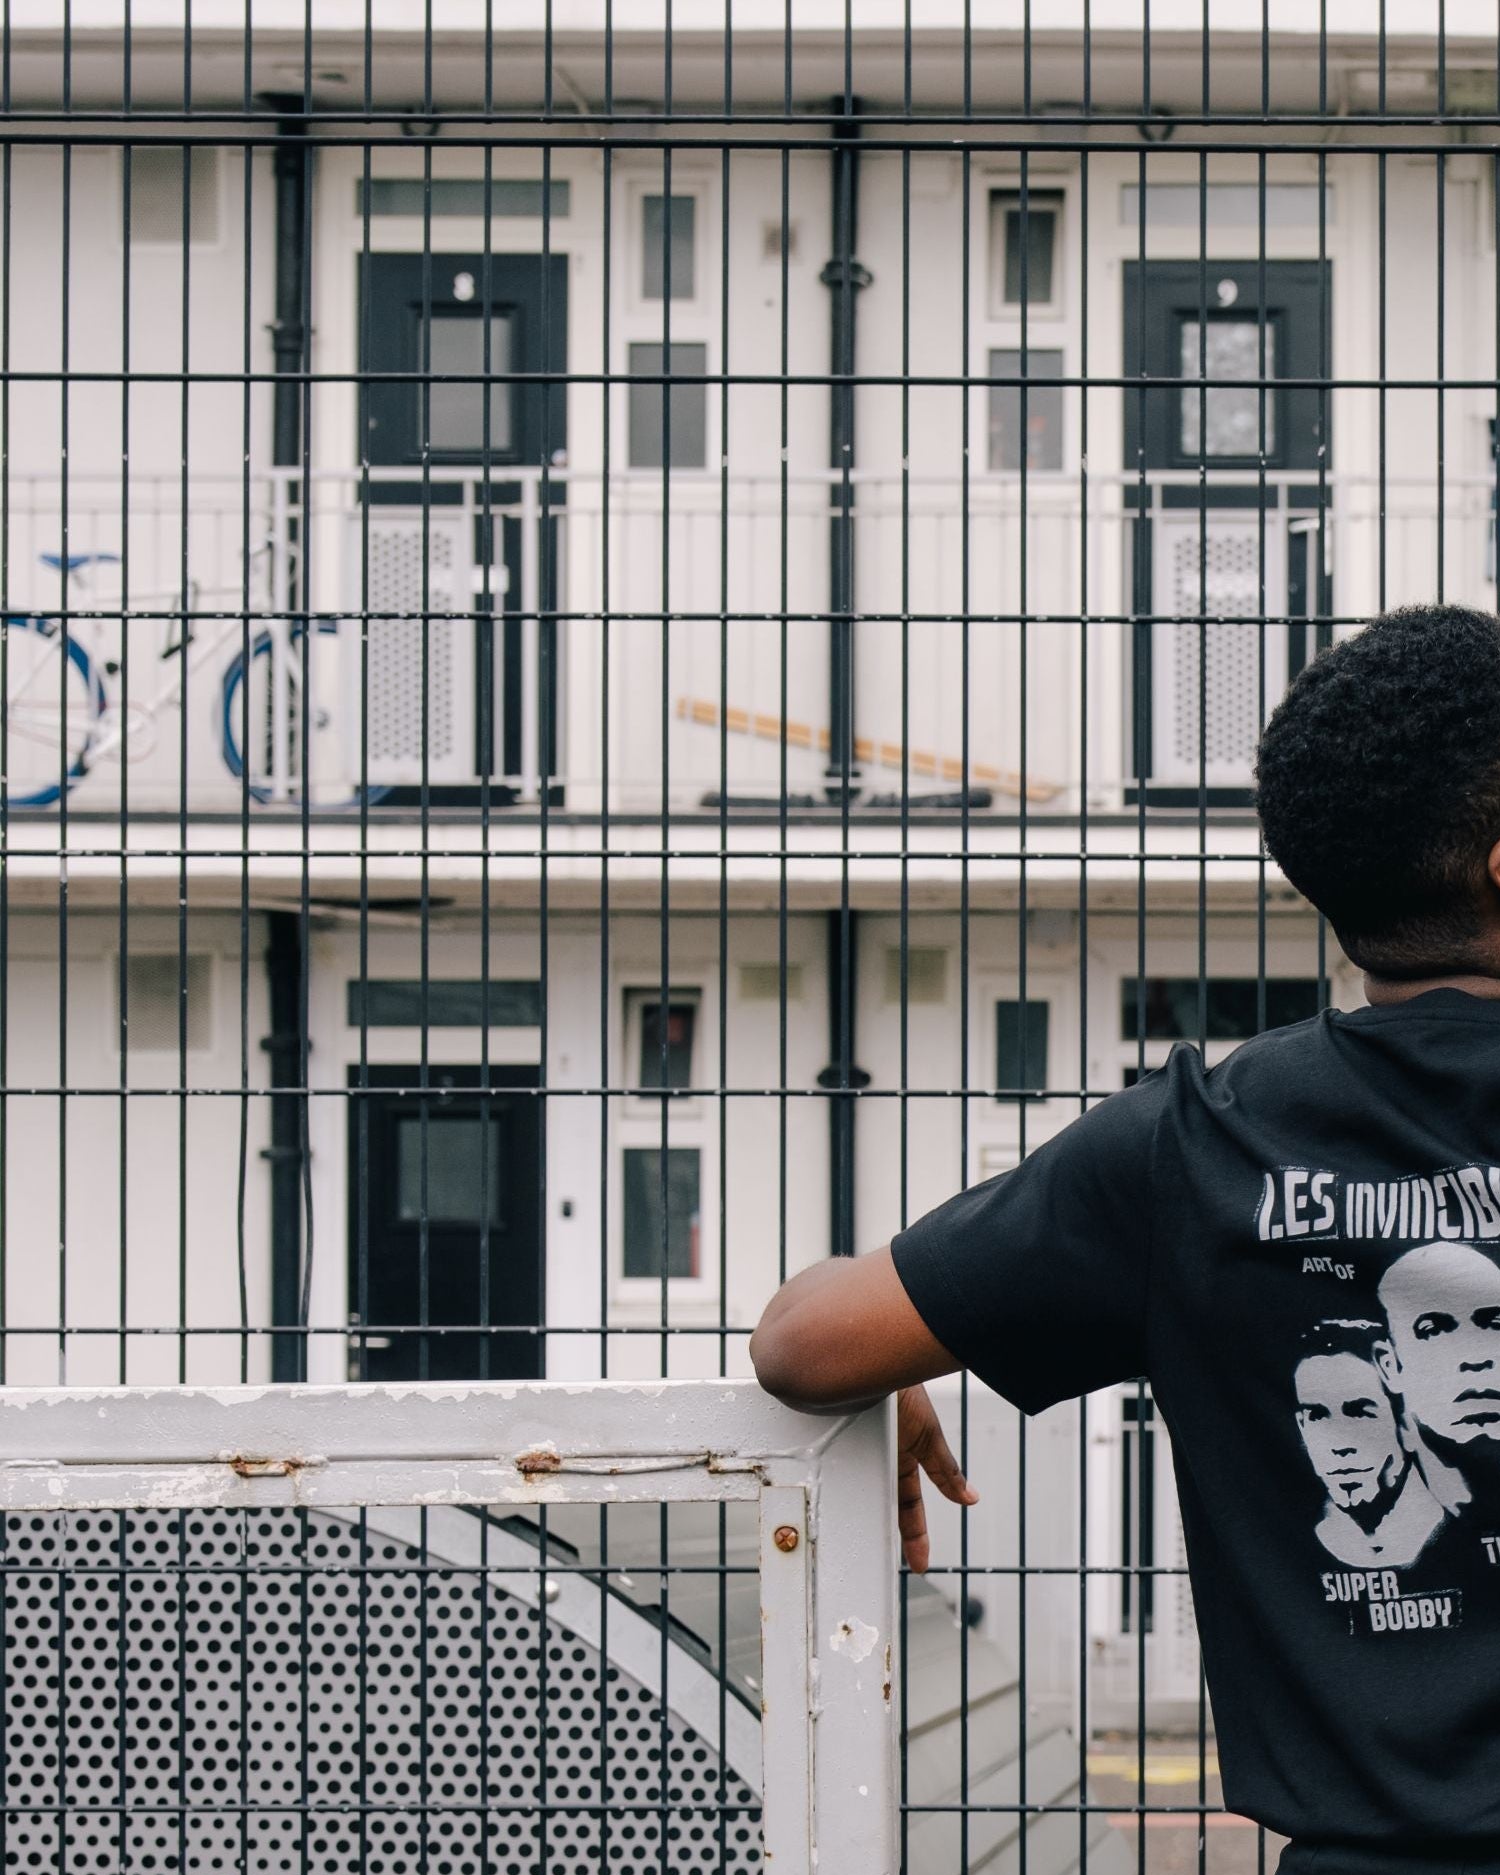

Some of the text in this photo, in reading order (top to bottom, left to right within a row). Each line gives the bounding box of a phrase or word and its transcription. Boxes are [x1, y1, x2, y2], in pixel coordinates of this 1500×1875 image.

[1217, 278, 1239, 309] 9
[1258, 1170, 1336, 1241] LES
[1302, 1256, 1356, 1281] ART OF
[1321, 1570, 1401, 1602] SUPER
[1368, 1597, 1453, 1632] BOBBY
